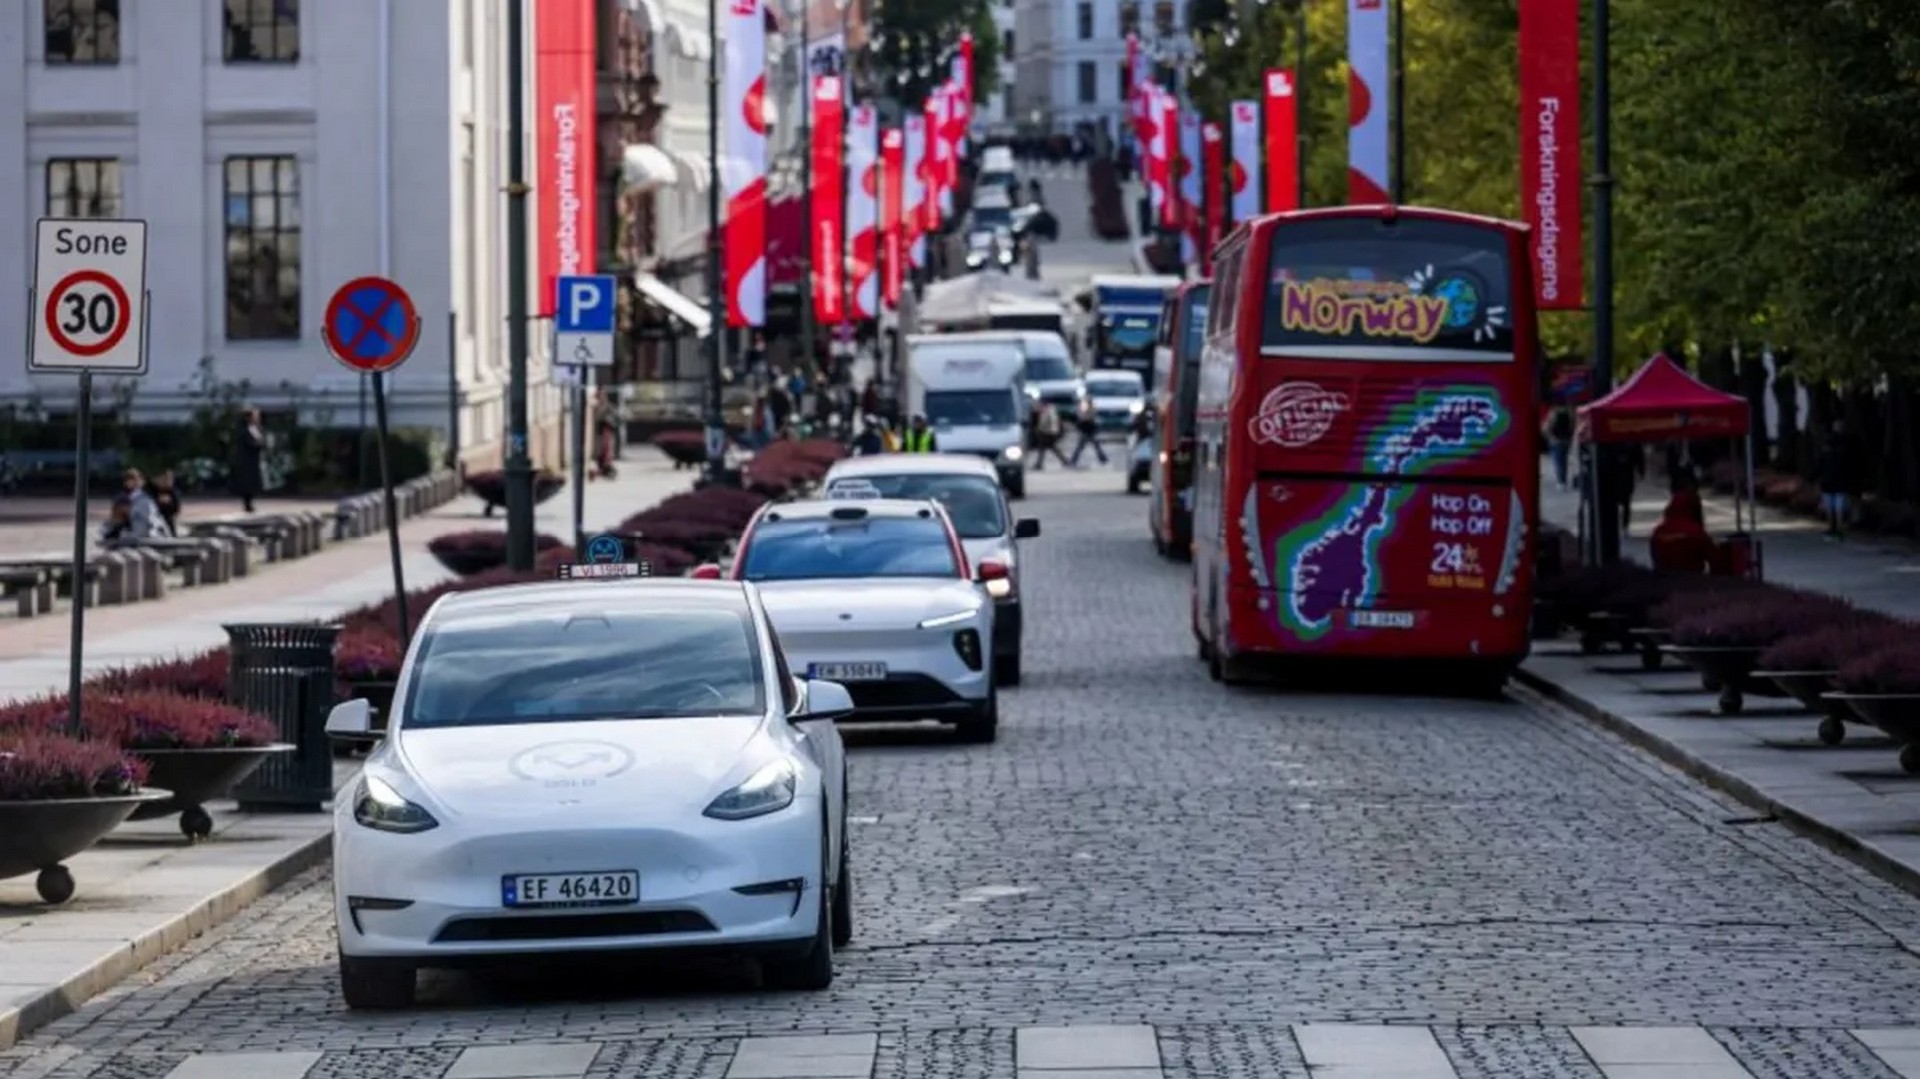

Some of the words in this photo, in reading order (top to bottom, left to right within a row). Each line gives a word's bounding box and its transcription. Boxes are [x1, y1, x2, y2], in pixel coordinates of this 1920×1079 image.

[1536, 97, 1560, 300] Forskningsdagene
[56, 228, 127, 255] Sone
[63, 293, 116, 334] 30
[570, 283, 600, 326] P
[1283, 280, 1446, 342] Norway
[1431, 494, 1463, 513] Hop
[1468, 494, 1490, 512] On
[1431, 515, 1463, 535] Hop
[1467, 516, 1492, 534] Off
[1431, 542, 1462, 572] 24
[523, 878, 548, 900] EF
[559, 875, 631, 898] 46420
